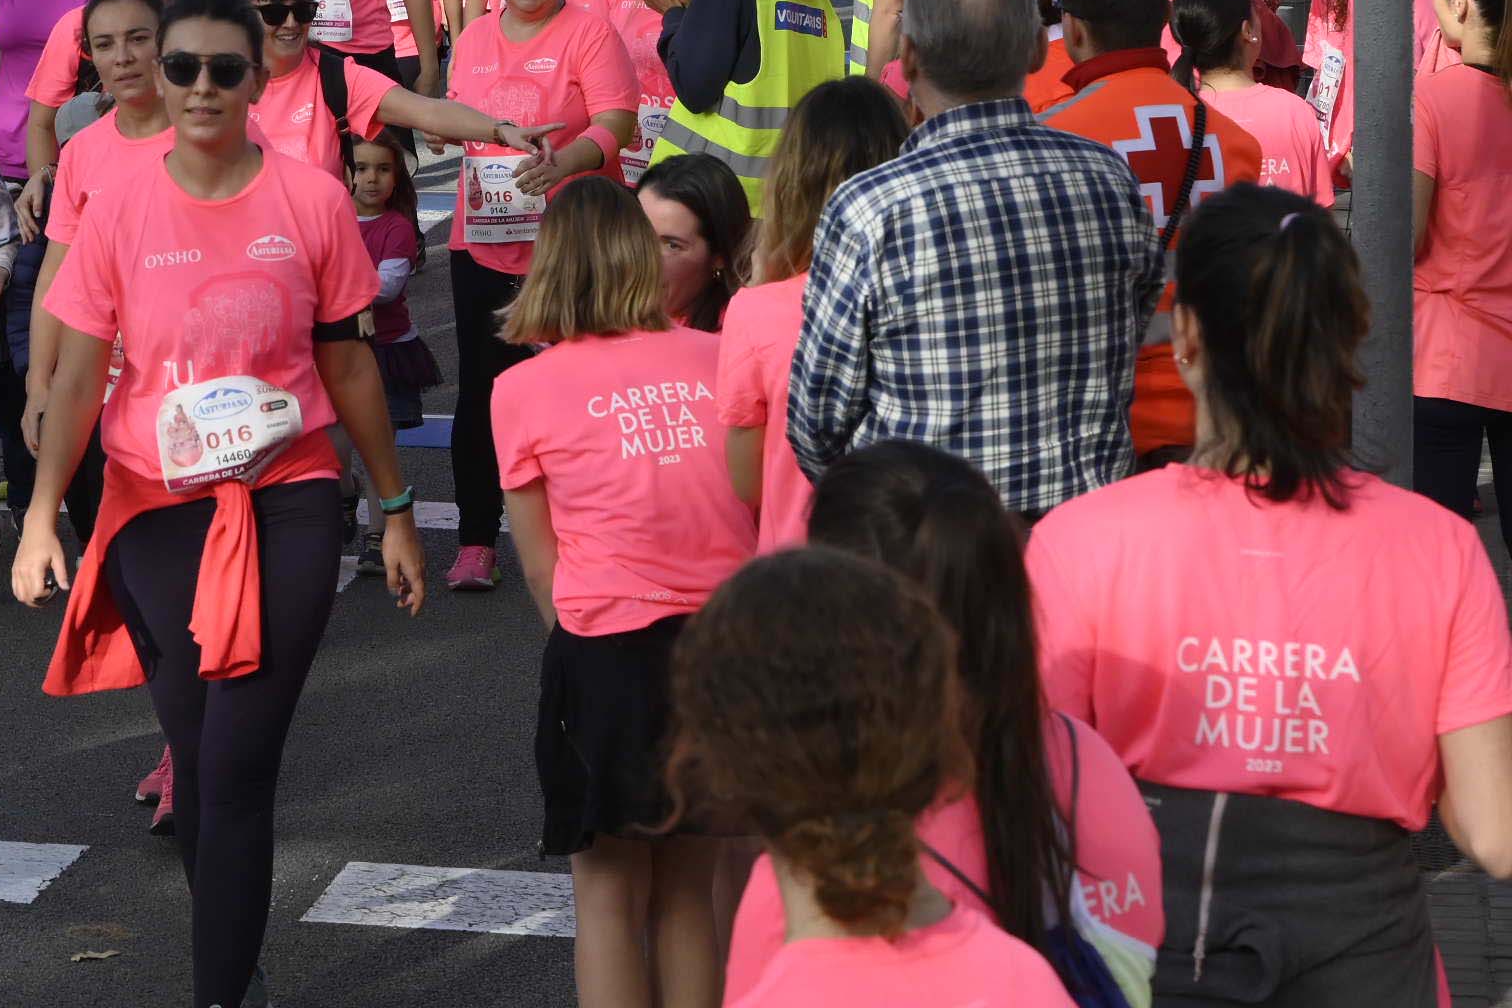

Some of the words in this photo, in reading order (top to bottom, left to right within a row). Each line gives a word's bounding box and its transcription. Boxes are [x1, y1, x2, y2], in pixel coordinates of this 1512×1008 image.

[484, 190, 513, 204] 016
[144, 250, 202, 269] OYSHO
[163, 359, 194, 388] TU
[587, 380, 714, 419] CARRERA
[618, 409, 656, 432] DE
[664, 404, 697, 428] LA
[206, 424, 254, 449] 016
[620, 428, 707, 460] MUJER
[215, 448, 253, 466] 14460
[658, 454, 681, 466] 2023
[182, 472, 221, 486] CARRERA
[221, 470, 234, 478] DE
[234, 466, 245, 475] LA
[1176, 636, 1361, 683] CARRERA
[1205, 674, 1258, 711] DE
[1275, 680, 1322, 717] LA
[1195, 713, 1330, 755] MUJER
[1245, 758, 1283, 774] 2023
